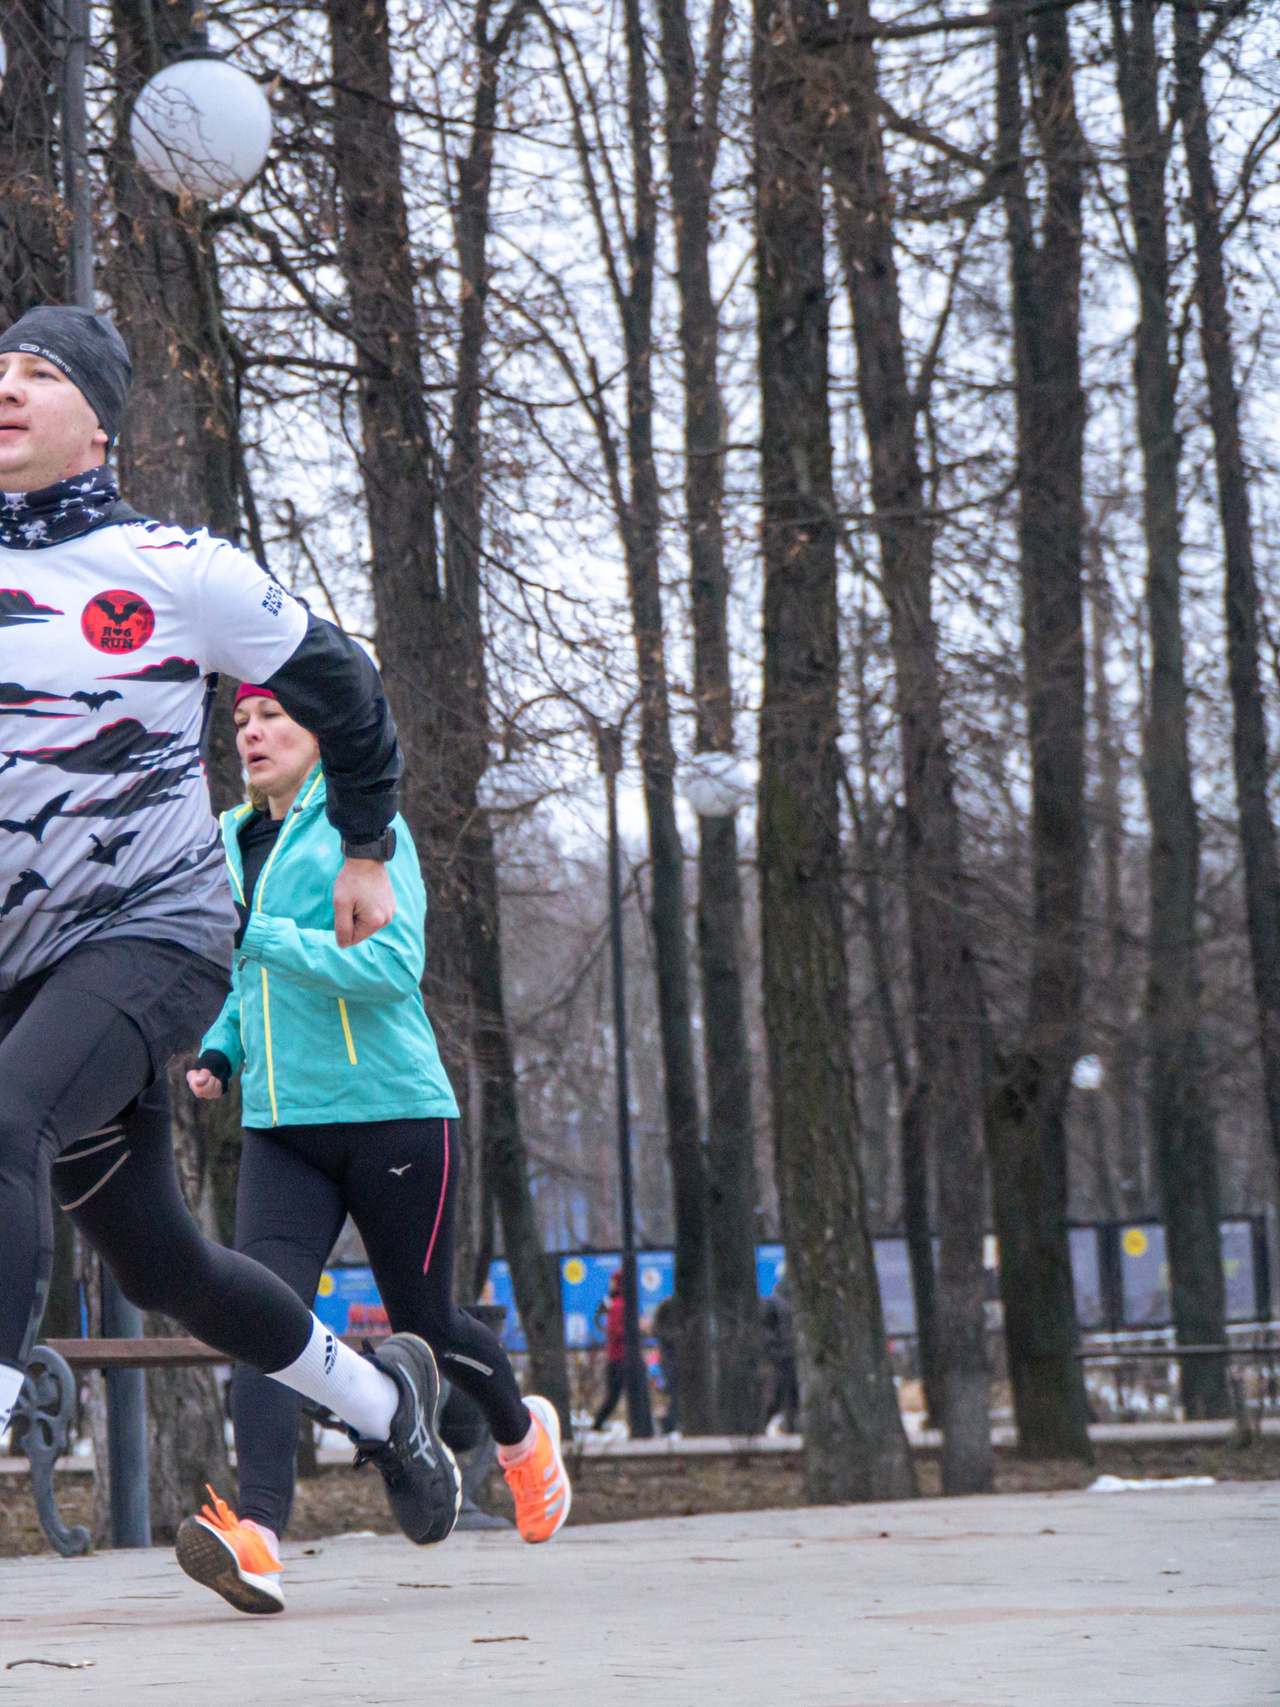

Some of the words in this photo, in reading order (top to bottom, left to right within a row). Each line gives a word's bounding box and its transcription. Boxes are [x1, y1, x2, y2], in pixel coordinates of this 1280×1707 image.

[41, 348, 72, 373] Kalenji
[261, 585, 273, 608] RUN
[100, 637, 134, 650] RUN
